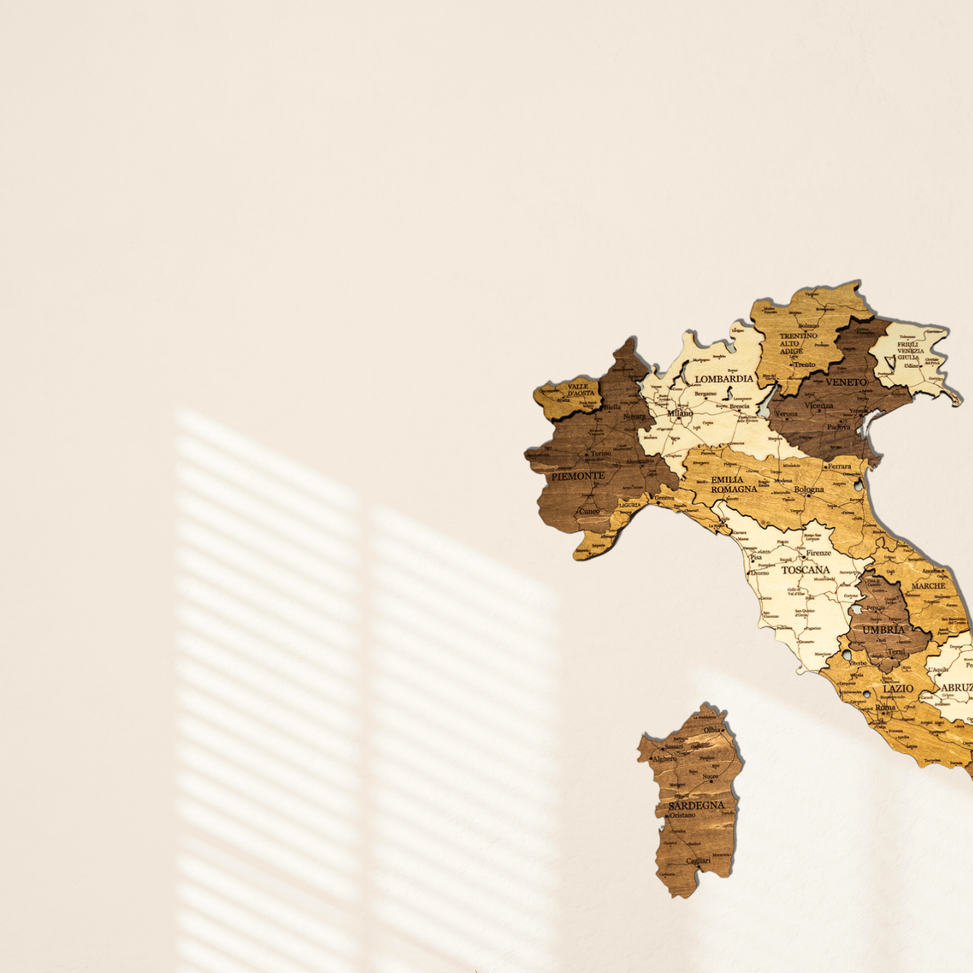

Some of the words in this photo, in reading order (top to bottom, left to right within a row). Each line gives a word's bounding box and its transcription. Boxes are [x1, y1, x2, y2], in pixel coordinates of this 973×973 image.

[695, 375, 754, 383] LOMBARDIA
[826, 378, 867, 386] VENETO
[667, 409, 693, 417] Milano
[552, 472, 605, 481] PIEMONTE
[794, 486, 825, 494] Bologna
[781, 566, 830, 574] TOSCANA
[863, 626, 905, 634] UMBRIA
[883, 685, 914, 693] LAZIO
[668, 801, 725, 810] SARDEGNA
